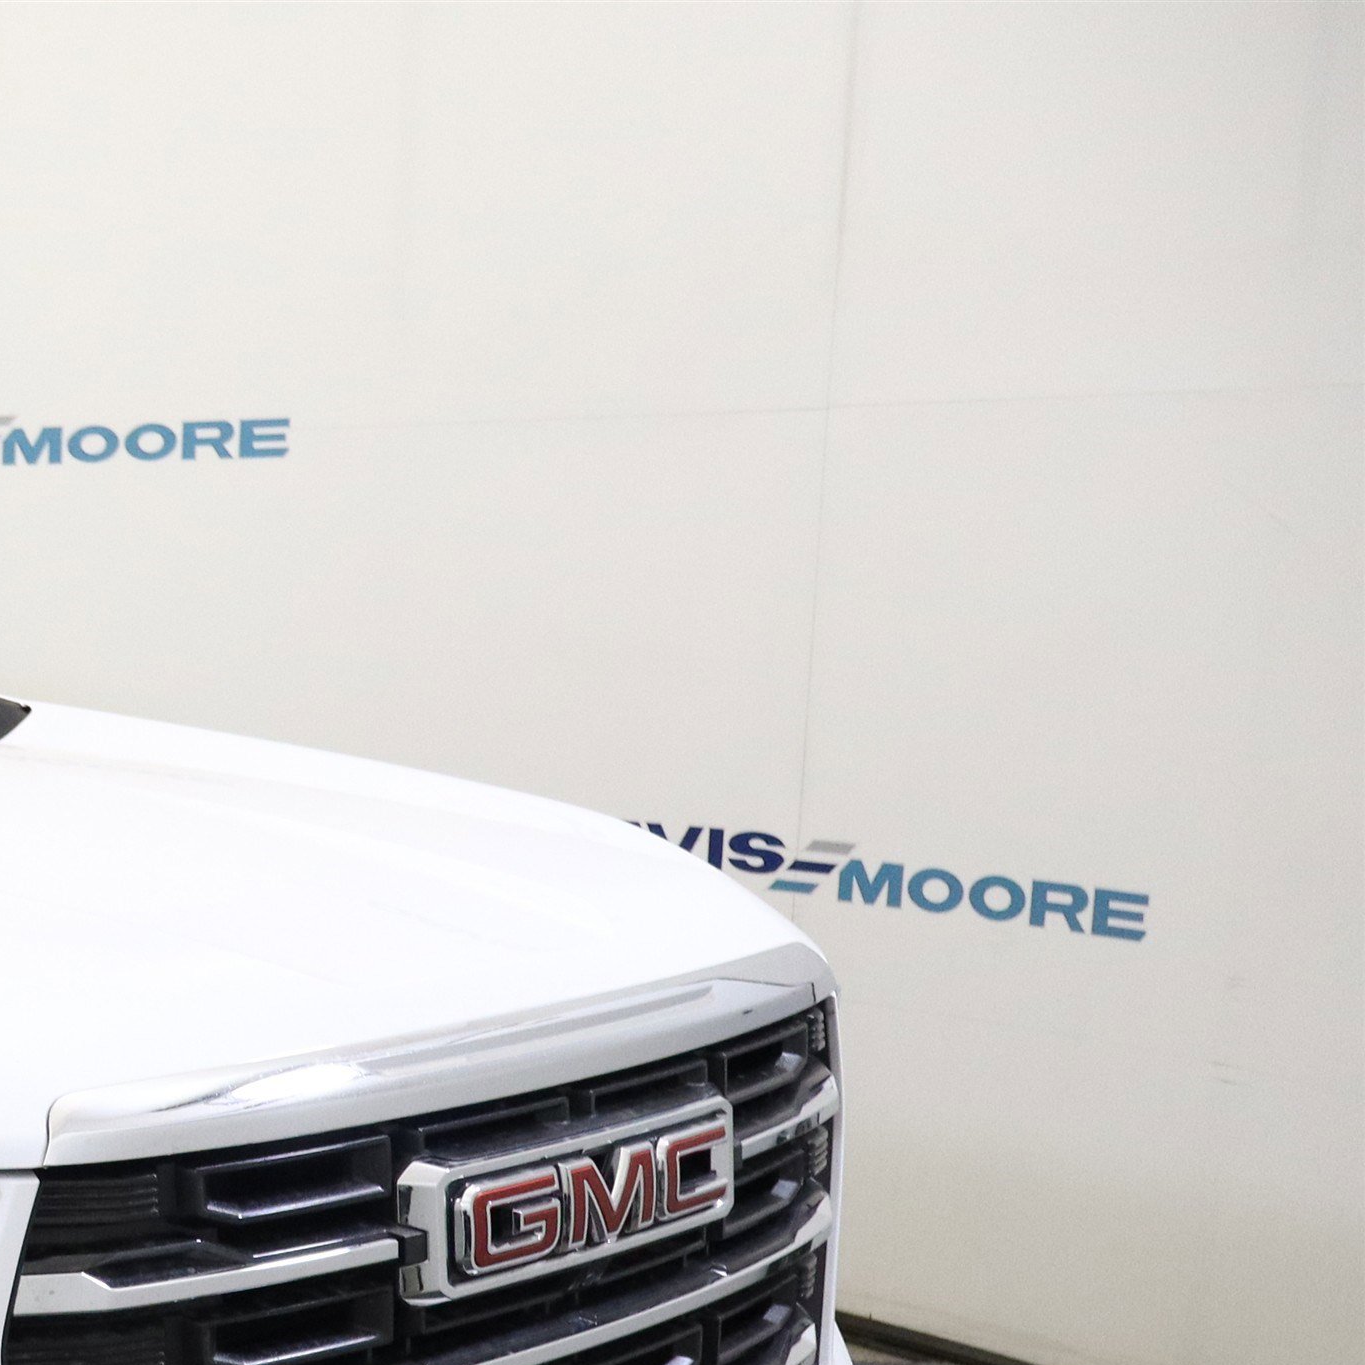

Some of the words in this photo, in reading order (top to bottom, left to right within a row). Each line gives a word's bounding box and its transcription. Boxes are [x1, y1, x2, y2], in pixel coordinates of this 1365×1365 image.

[1, 417, 291, 466] MOORE
[837, 858, 1150, 942] MOORE
[461, 1122, 730, 1277] GMC
